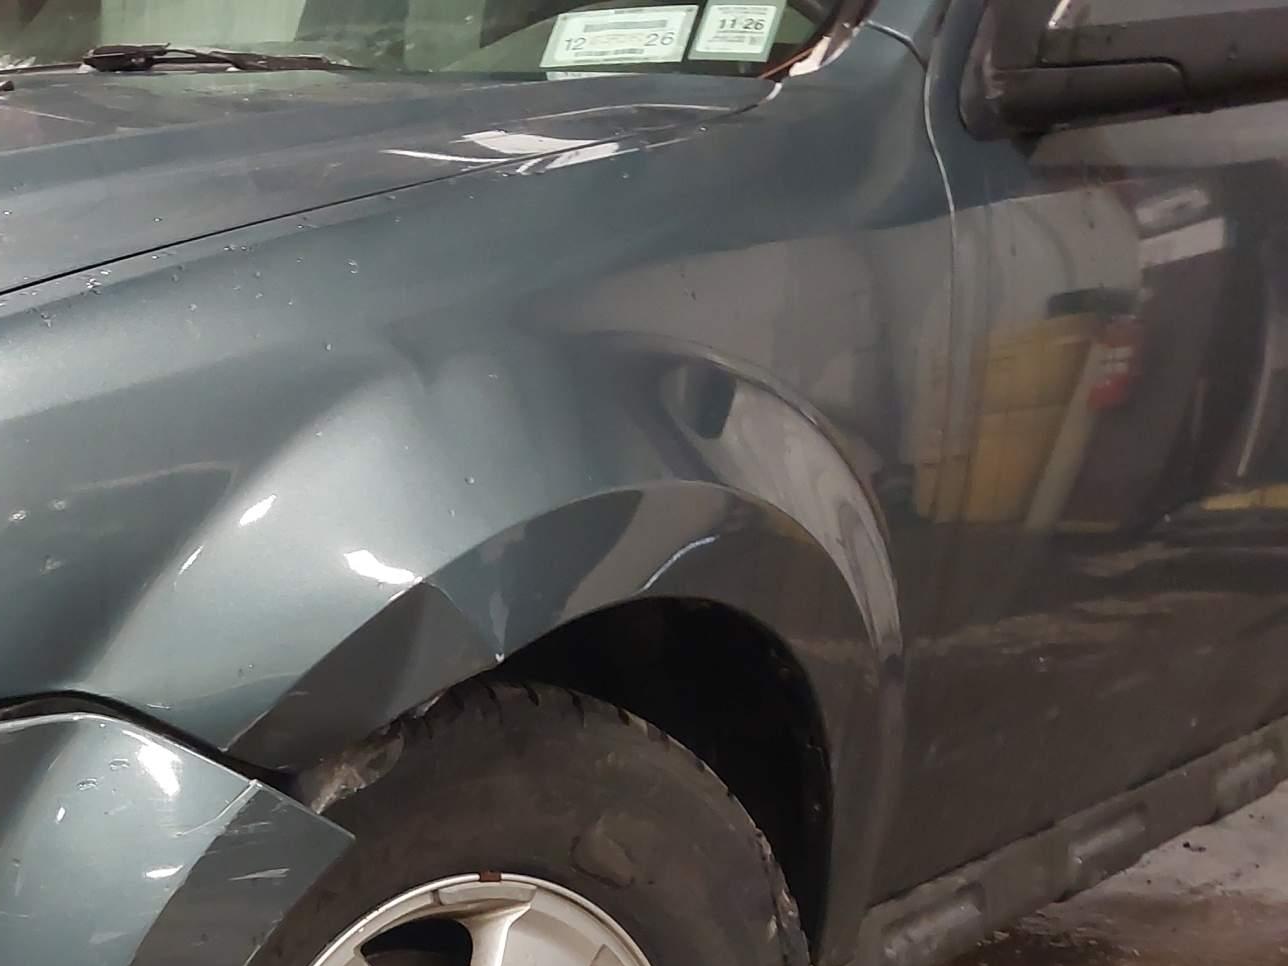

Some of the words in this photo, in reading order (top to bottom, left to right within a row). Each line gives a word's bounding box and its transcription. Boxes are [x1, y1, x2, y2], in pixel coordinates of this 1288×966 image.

[743, 18, 766, 31] 26
[565, 37, 586, 51] 12
[644, 32, 674, 46] 26
